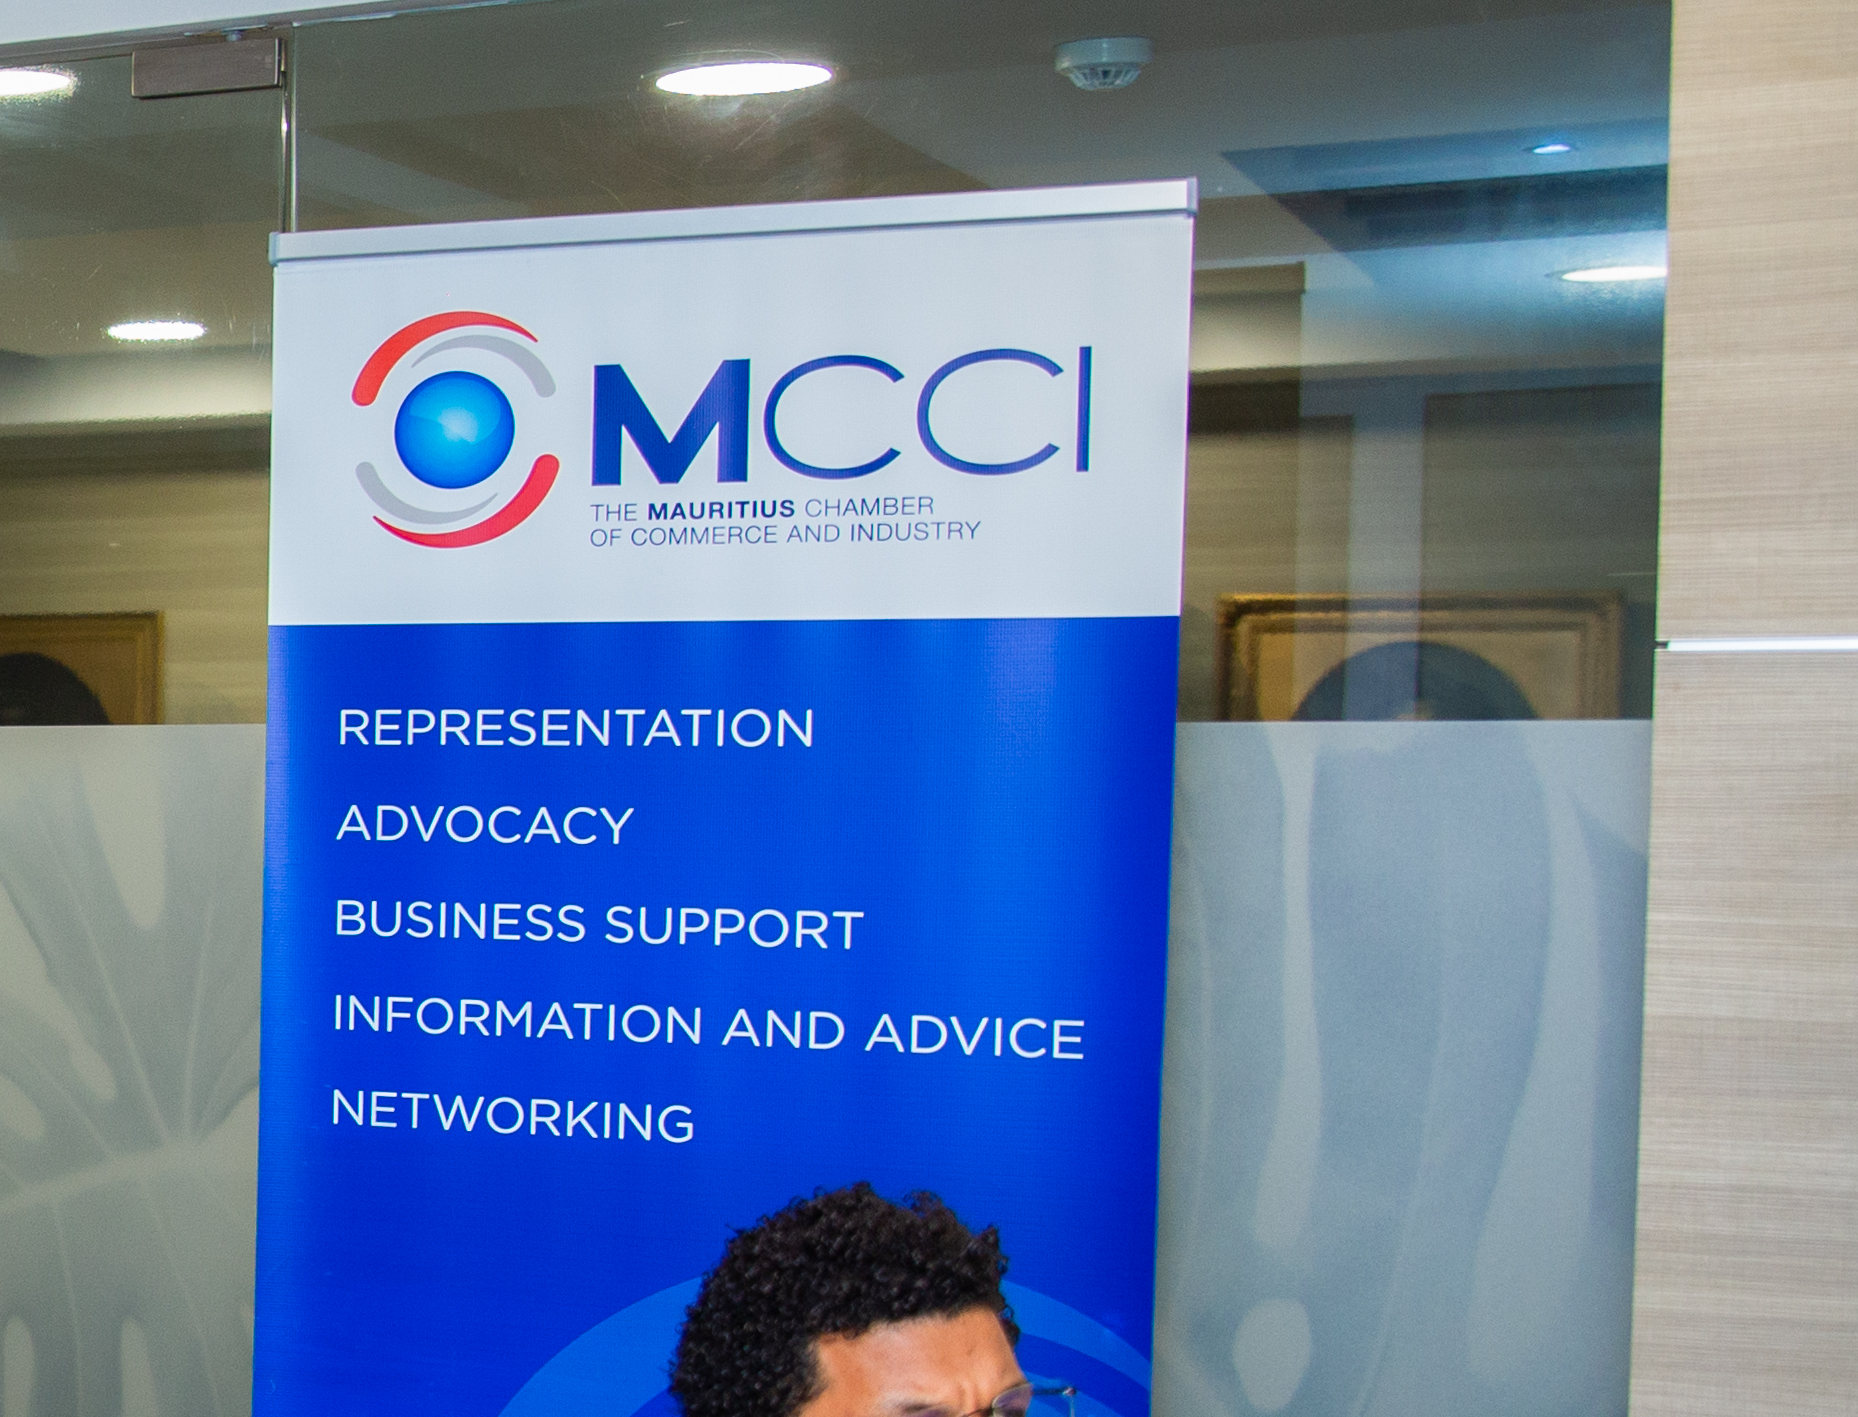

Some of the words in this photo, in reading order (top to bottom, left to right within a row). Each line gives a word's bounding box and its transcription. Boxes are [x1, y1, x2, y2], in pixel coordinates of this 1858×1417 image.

[591, 346, 1093, 487] MCCI
[590, 503, 637, 522] THE
[647, 499, 796, 521] MAURITIUS
[805, 496, 934, 518] CHAMBER
[590, 527, 622, 547] OF
[631, 525, 778, 546] COMMERCE
[786, 524, 841, 544] AND
[850, 521, 981, 542] INDUSTRY
[339, 708, 814, 748] REPRESENTATION
[336, 804, 634, 846] ADVOCACY
[336, 899, 585, 943] BUSINESS
[605, 906, 864, 950] SUPPORT
[333, 994, 702, 1046] INFORMATION
[722, 1008, 845, 1051] AND
[865, 1014, 1084, 1060] ADVICE
[331, 1089, 694, 1143] NETWORKING
